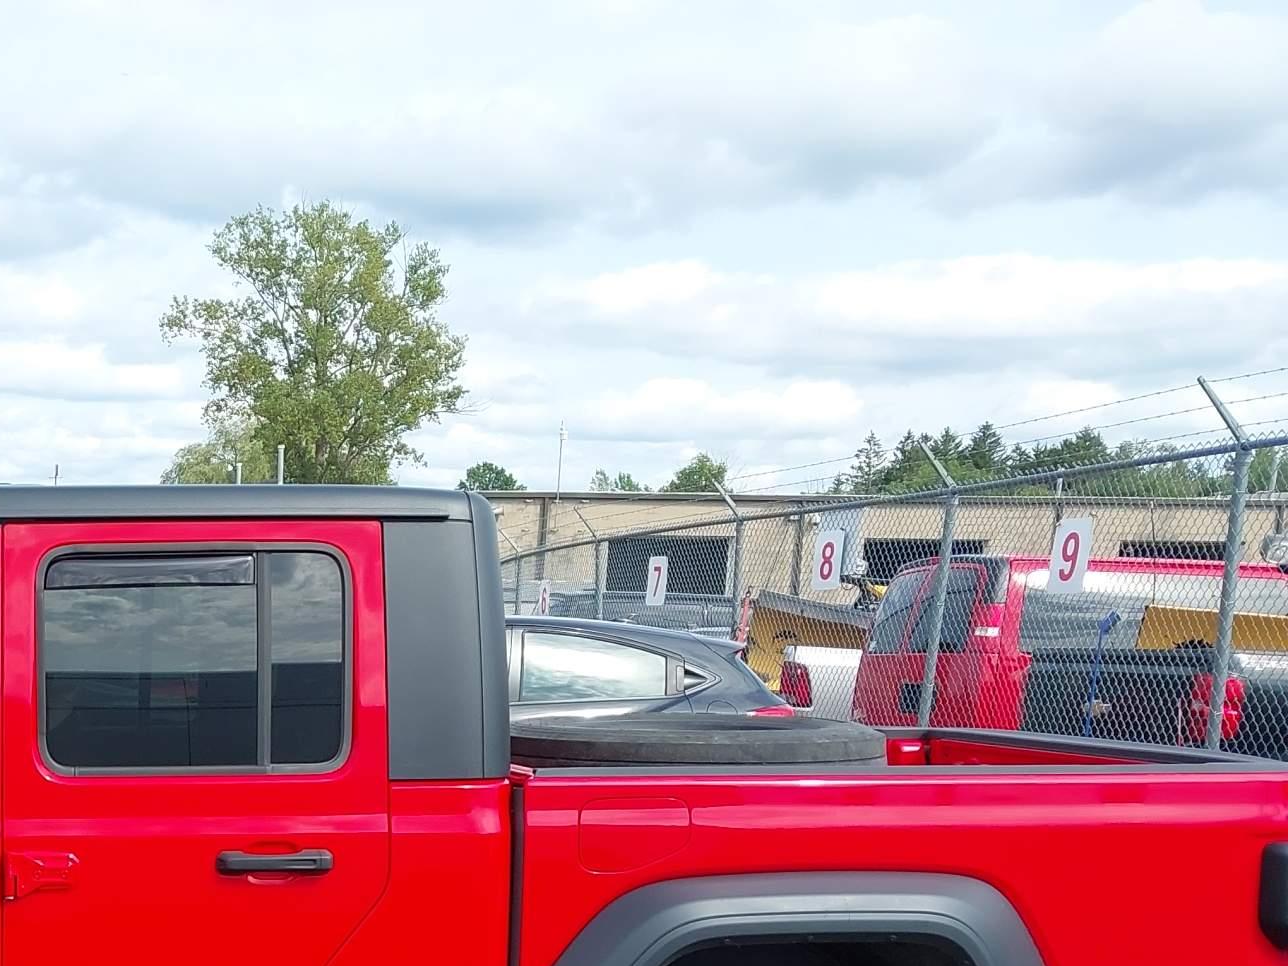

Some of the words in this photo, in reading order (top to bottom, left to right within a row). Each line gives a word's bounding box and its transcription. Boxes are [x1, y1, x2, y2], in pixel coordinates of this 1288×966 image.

[819, 541, 835, 581] 8
[1058, 531, 1080, 582] 9
[653, 566, 662, 597] 7
[541, 586, 547, 615] 6
